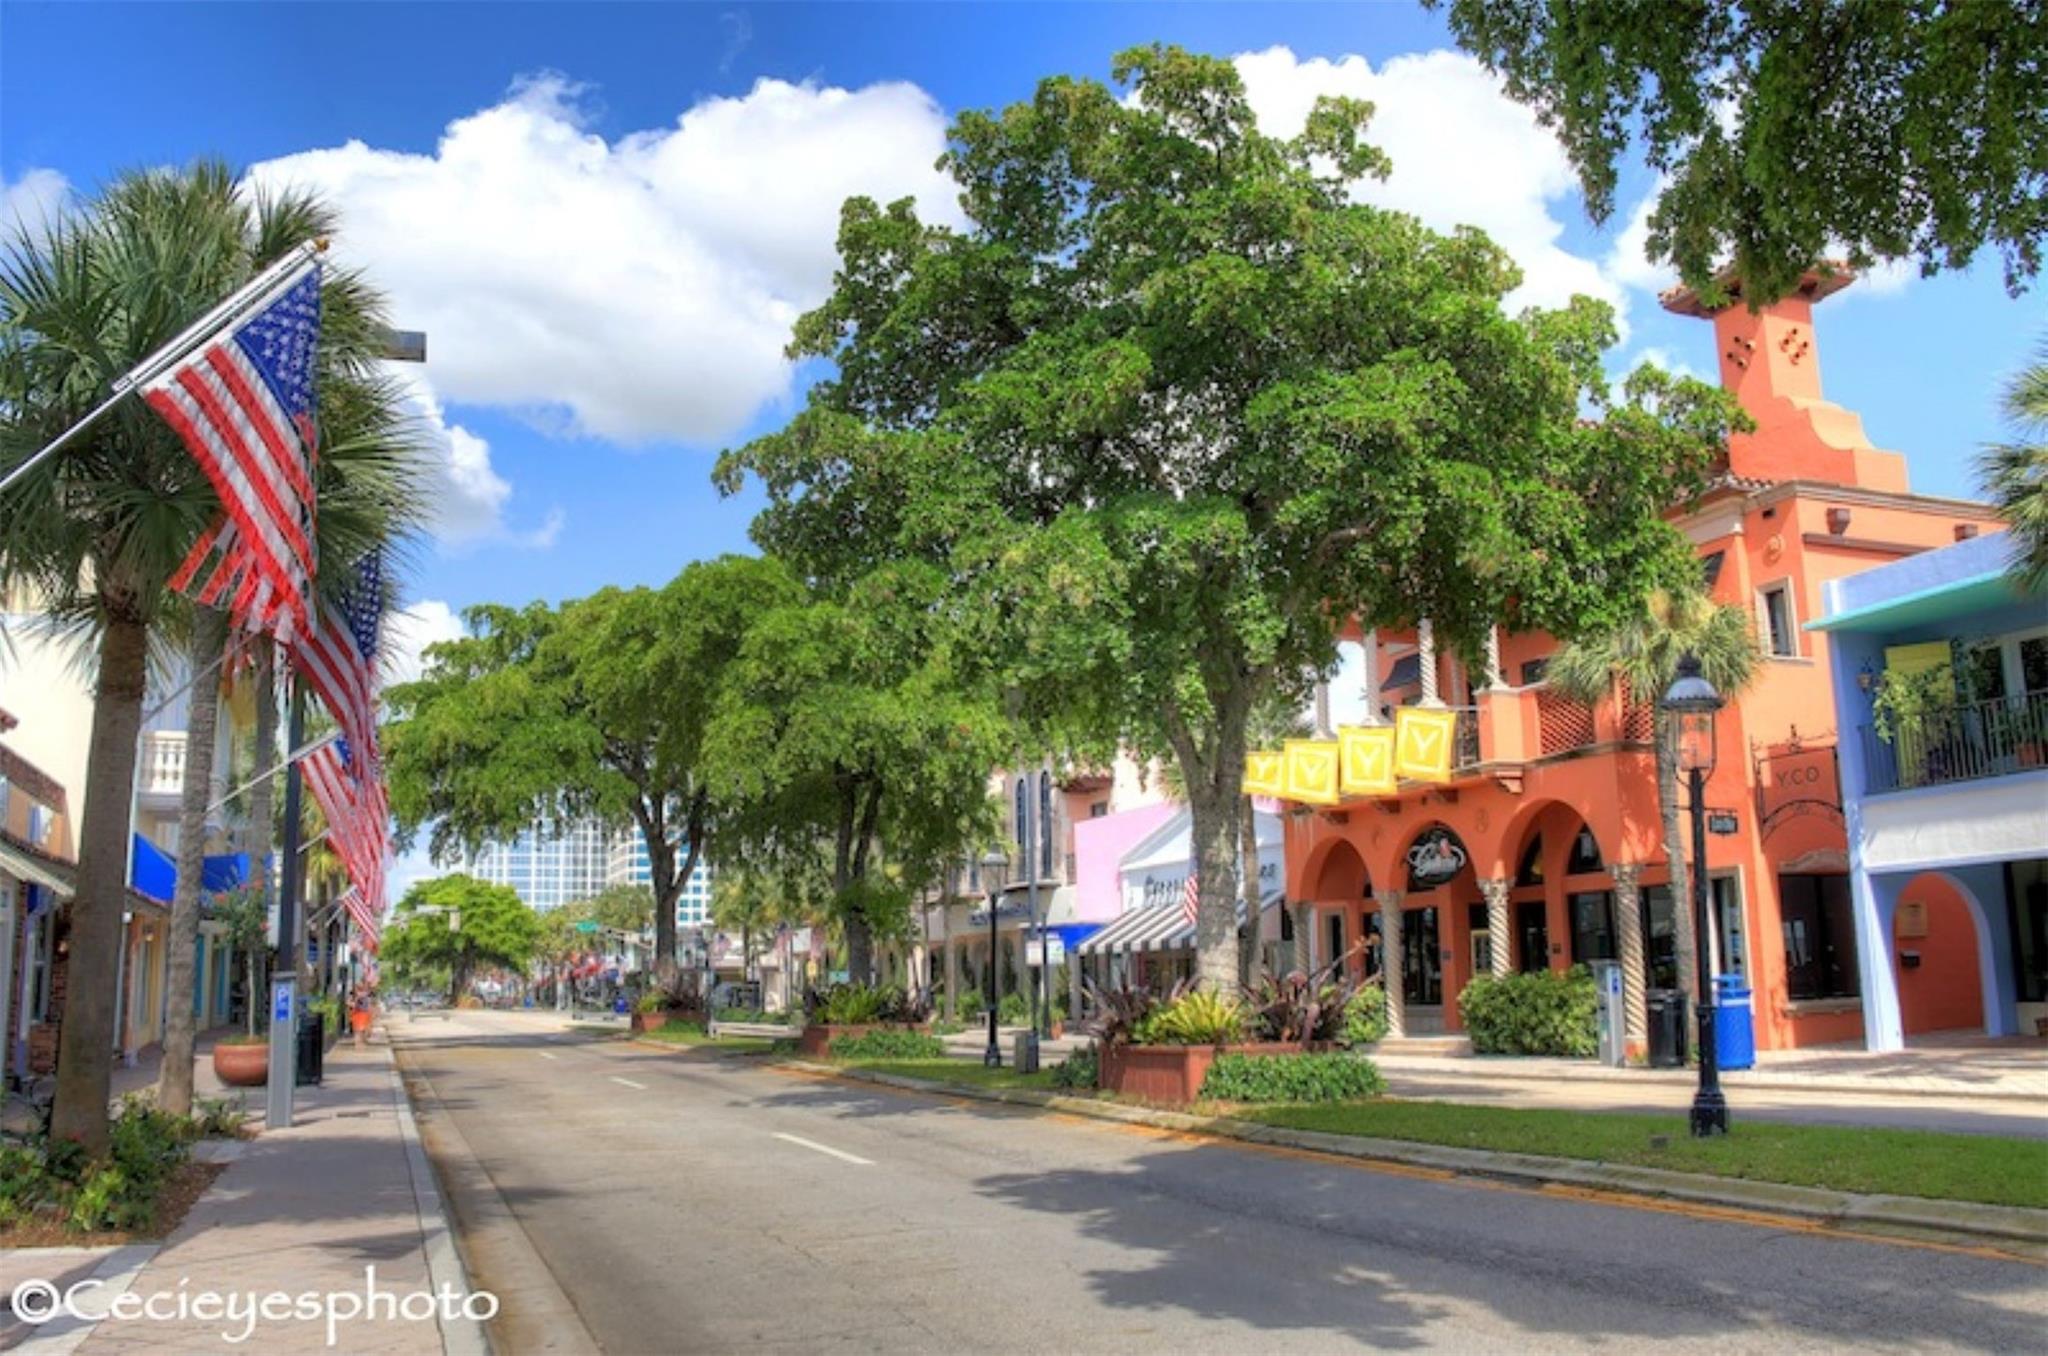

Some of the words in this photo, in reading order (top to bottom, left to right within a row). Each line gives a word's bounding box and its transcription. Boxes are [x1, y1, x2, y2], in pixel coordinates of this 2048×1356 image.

[1410, 726, 1442, 760] Y
[1252, 755, 1277, 777] Y
[1299, 757, 1327, 787] Y
[1355, 745, 1383, 777] Y
